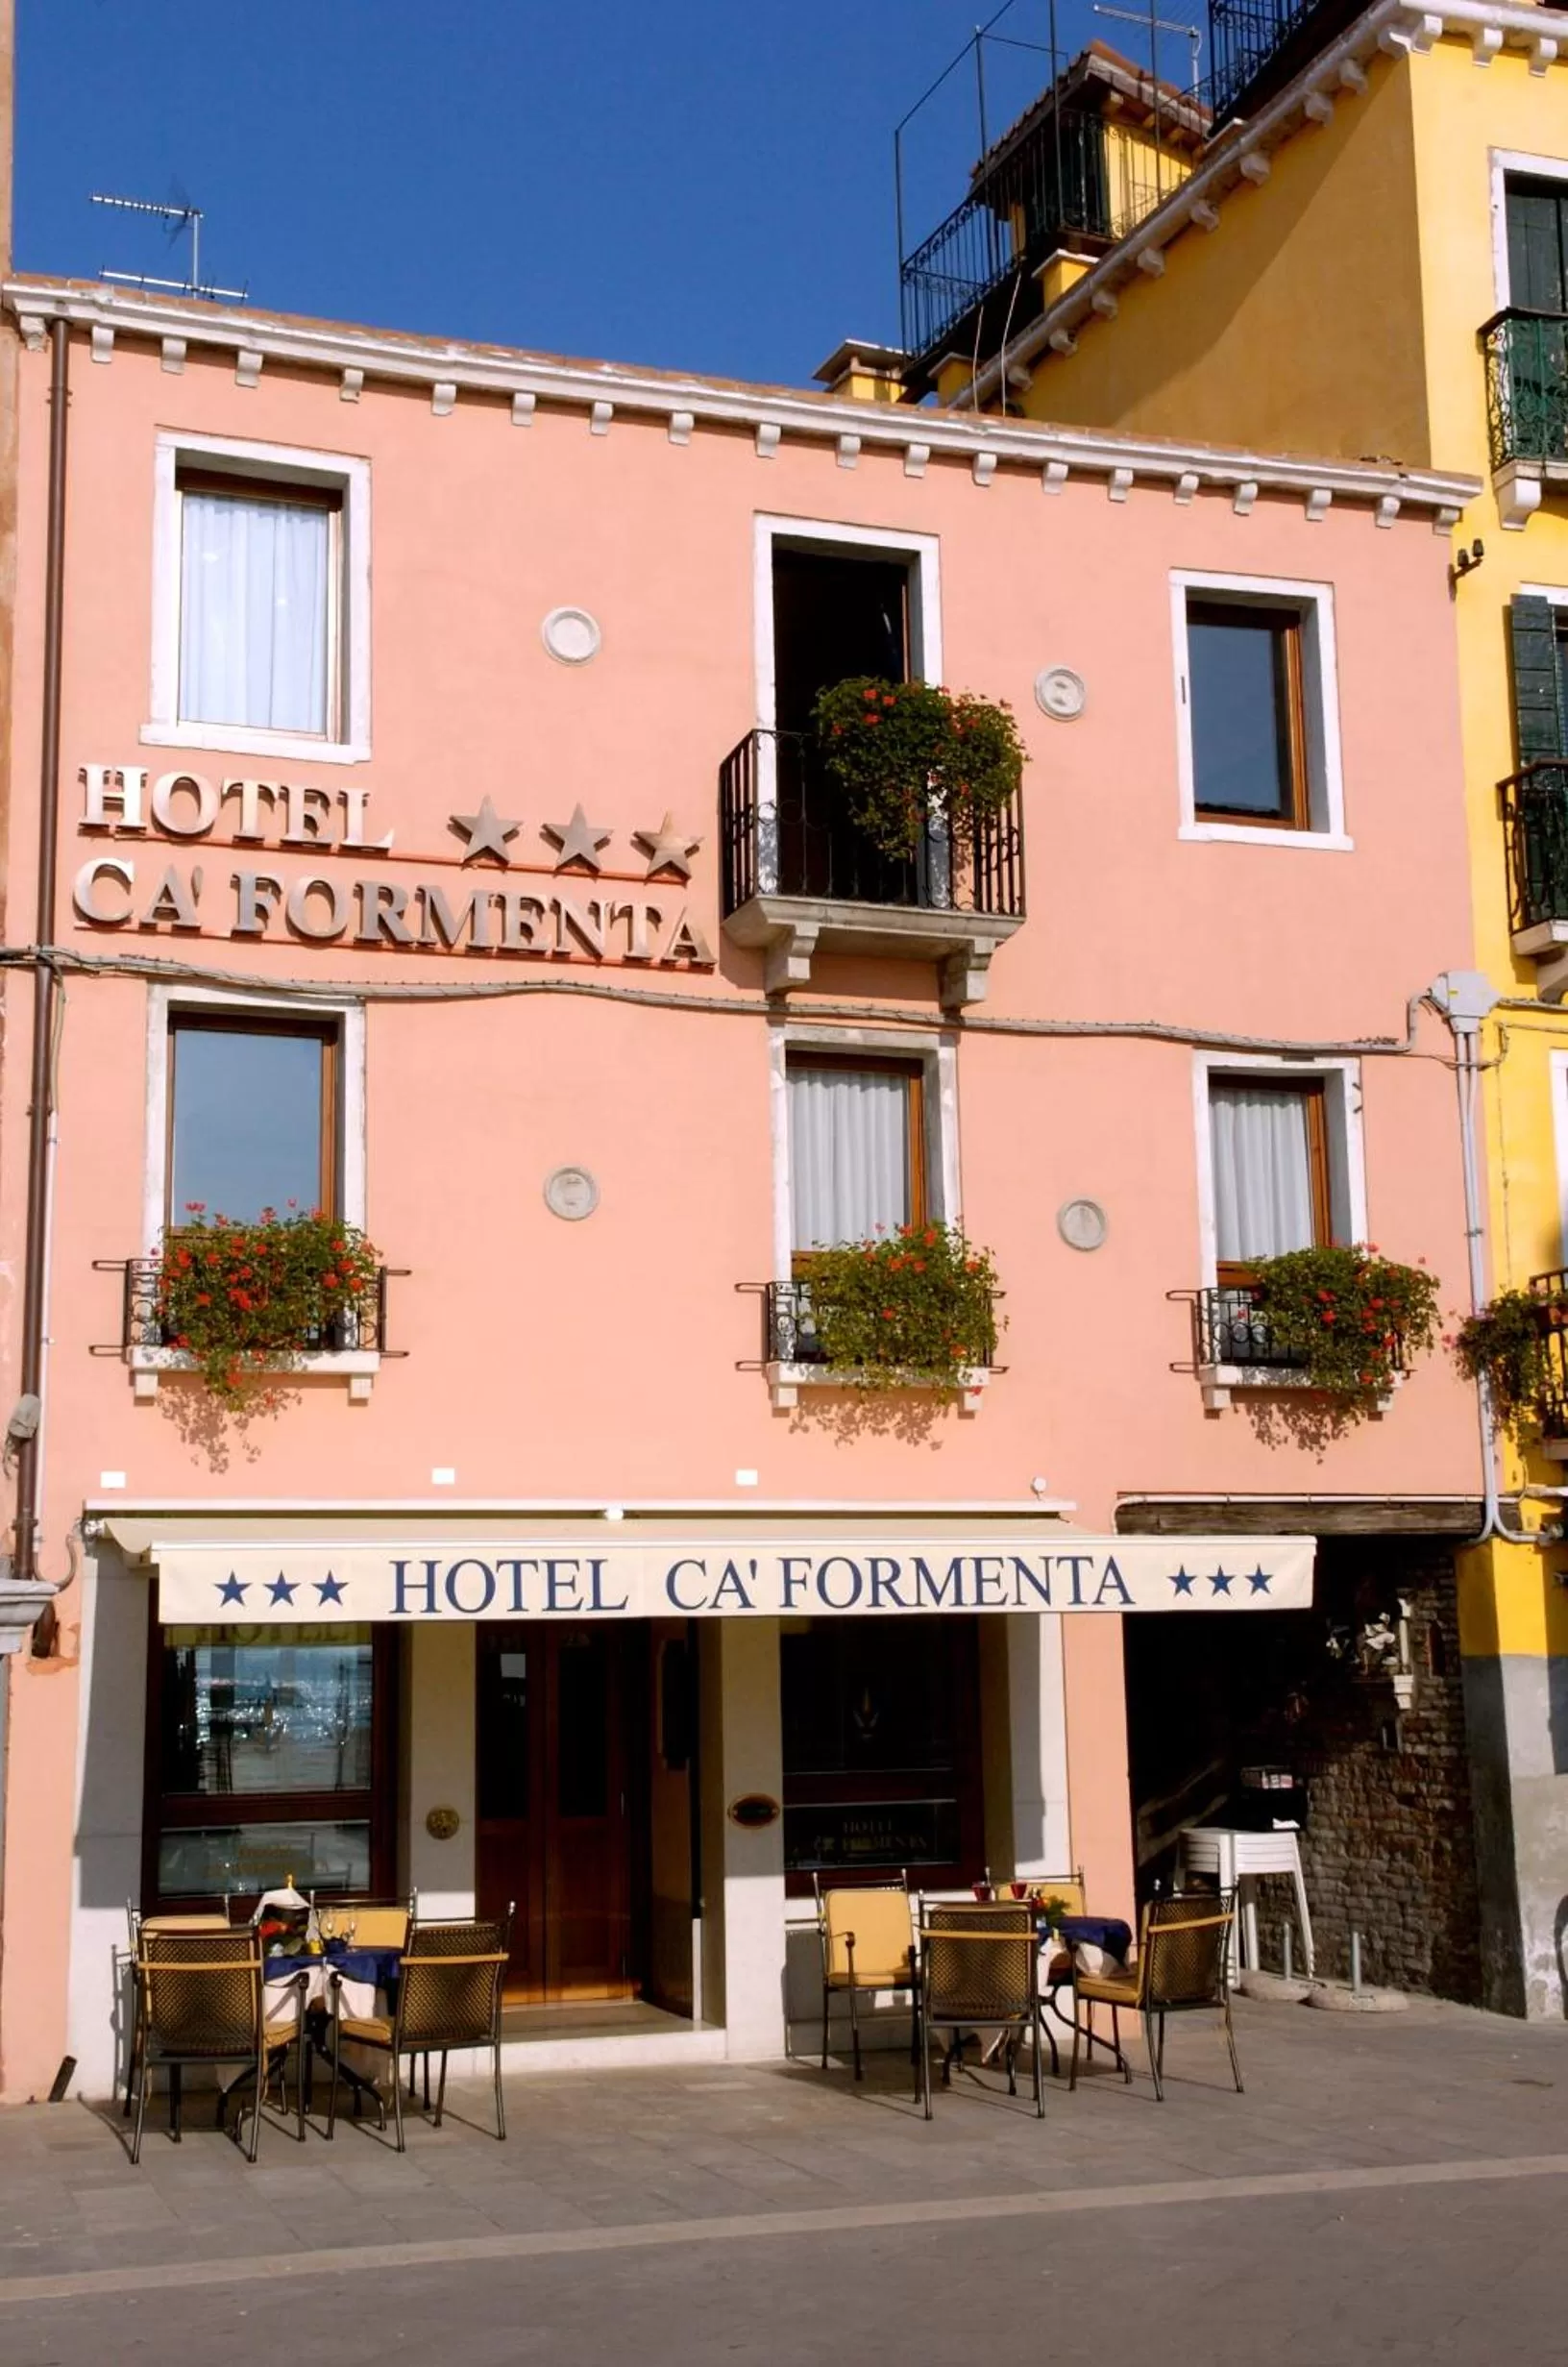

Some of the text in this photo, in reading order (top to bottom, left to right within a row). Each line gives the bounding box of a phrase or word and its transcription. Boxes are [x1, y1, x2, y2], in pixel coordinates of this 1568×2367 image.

[78, 764, 393, 851] HOTEL
[73, 857, 718, 965] CA' FORMENTA
[389, 1555, 1137, 1614] HOTEL CA' FORMENTA
